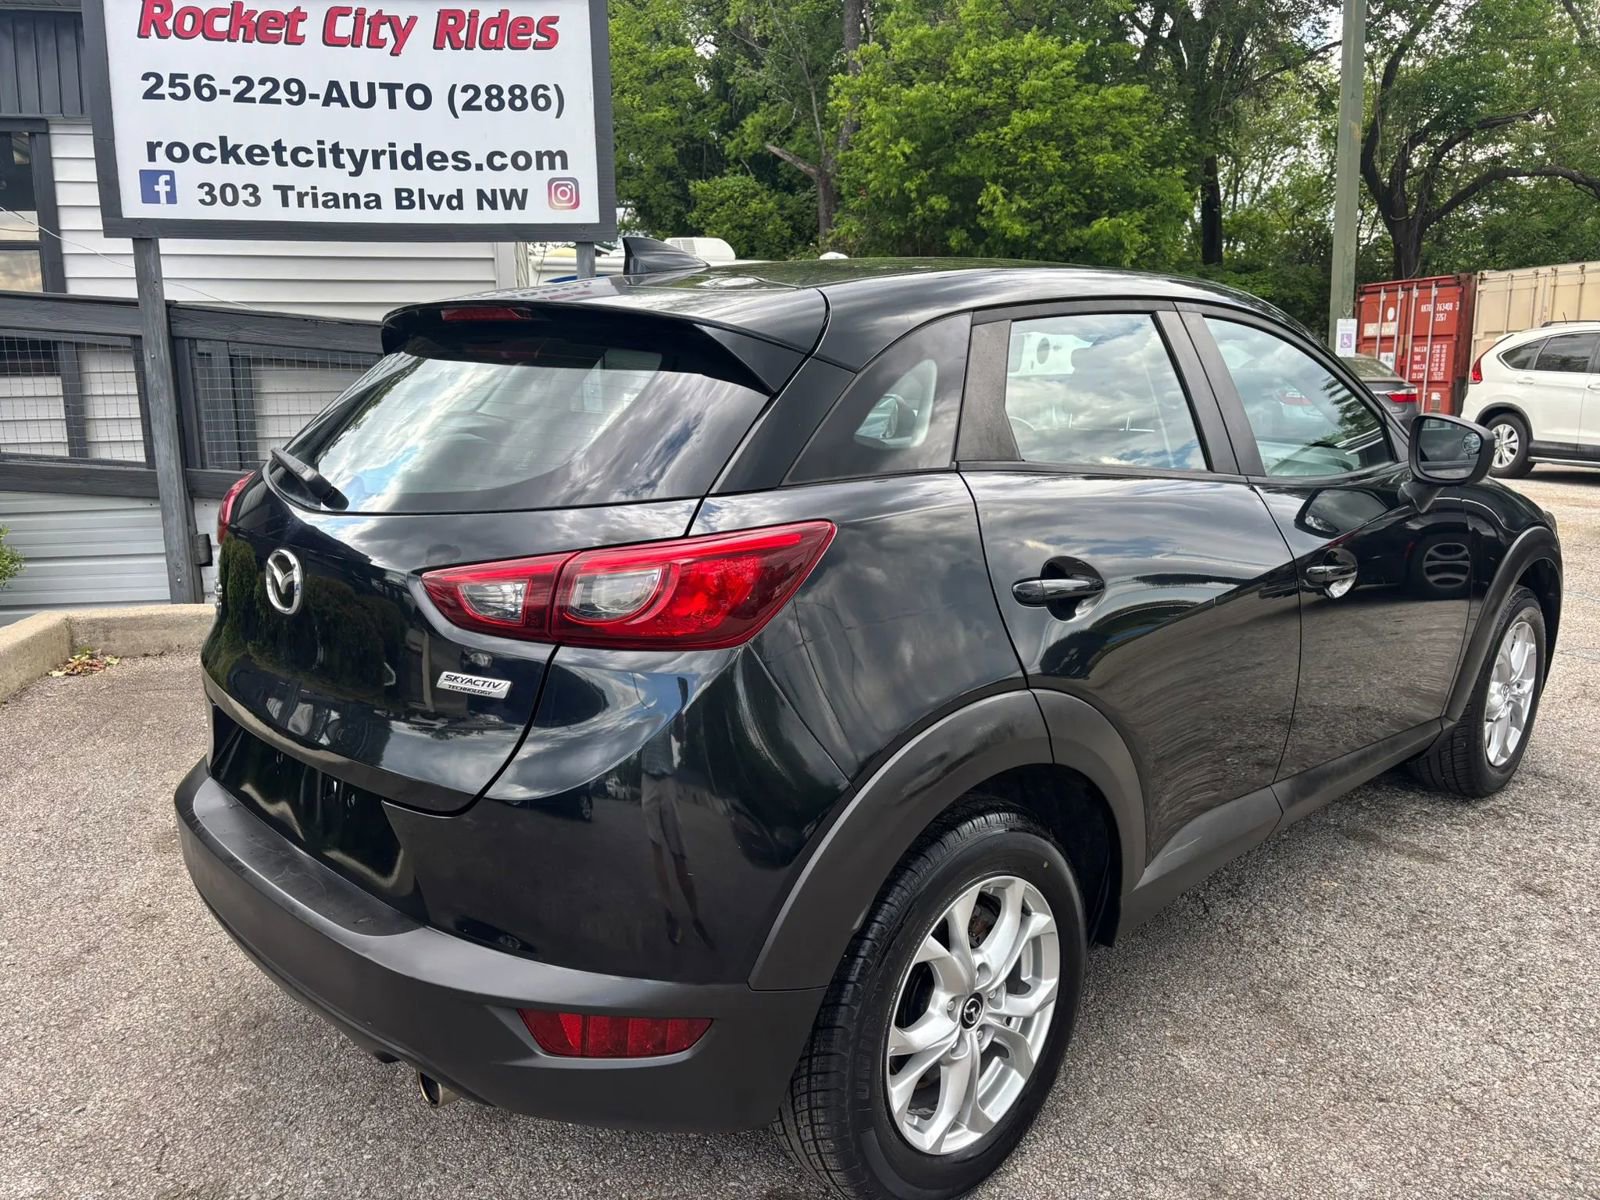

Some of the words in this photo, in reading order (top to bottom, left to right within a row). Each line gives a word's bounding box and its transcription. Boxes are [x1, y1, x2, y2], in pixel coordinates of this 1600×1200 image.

[137, 0, 307, 45] Rocket
[322, 6, 418, 56] City
[433, 9, 559, 50] Rides
[141, 72, 432, 110] 256-229-AUTO
[448, 84, 564, 119] (2886)
[146, 136, 569, 177] rocketcityrides.com
[198, 183, 261, 207] 303
[273, 185, 382, 209] Triana
[395, 188, 463, 211] Blvd
[477, 189, 529, 211] NW
[444, 674, 501, 689] SKYACTIV
[448, 684, 492, 696] TECHNOLOGY
